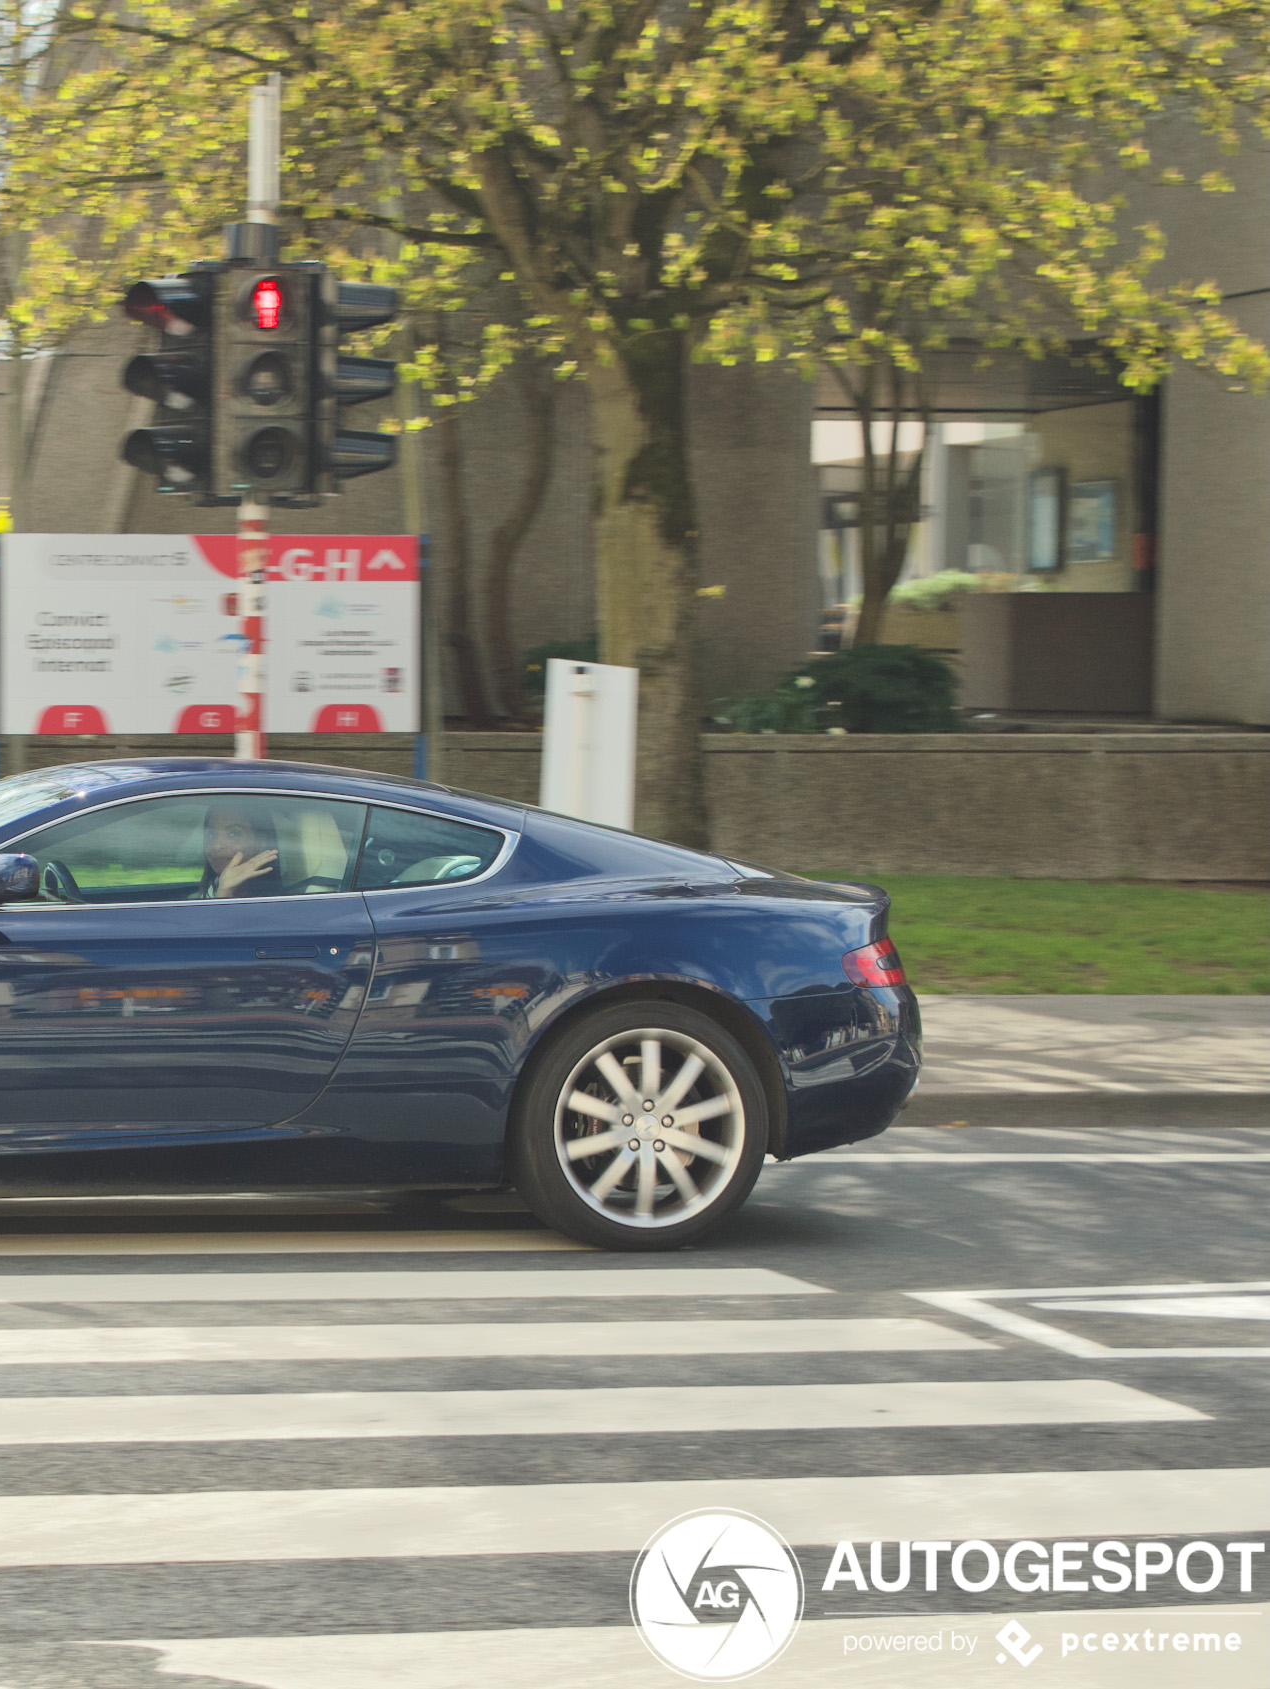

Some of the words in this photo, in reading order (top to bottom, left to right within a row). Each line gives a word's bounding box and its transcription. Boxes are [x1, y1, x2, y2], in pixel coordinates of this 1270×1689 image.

[63, 712, 84, 727] F
[198, 711, 222, 727] G
[335, 711, 360, 727] H
